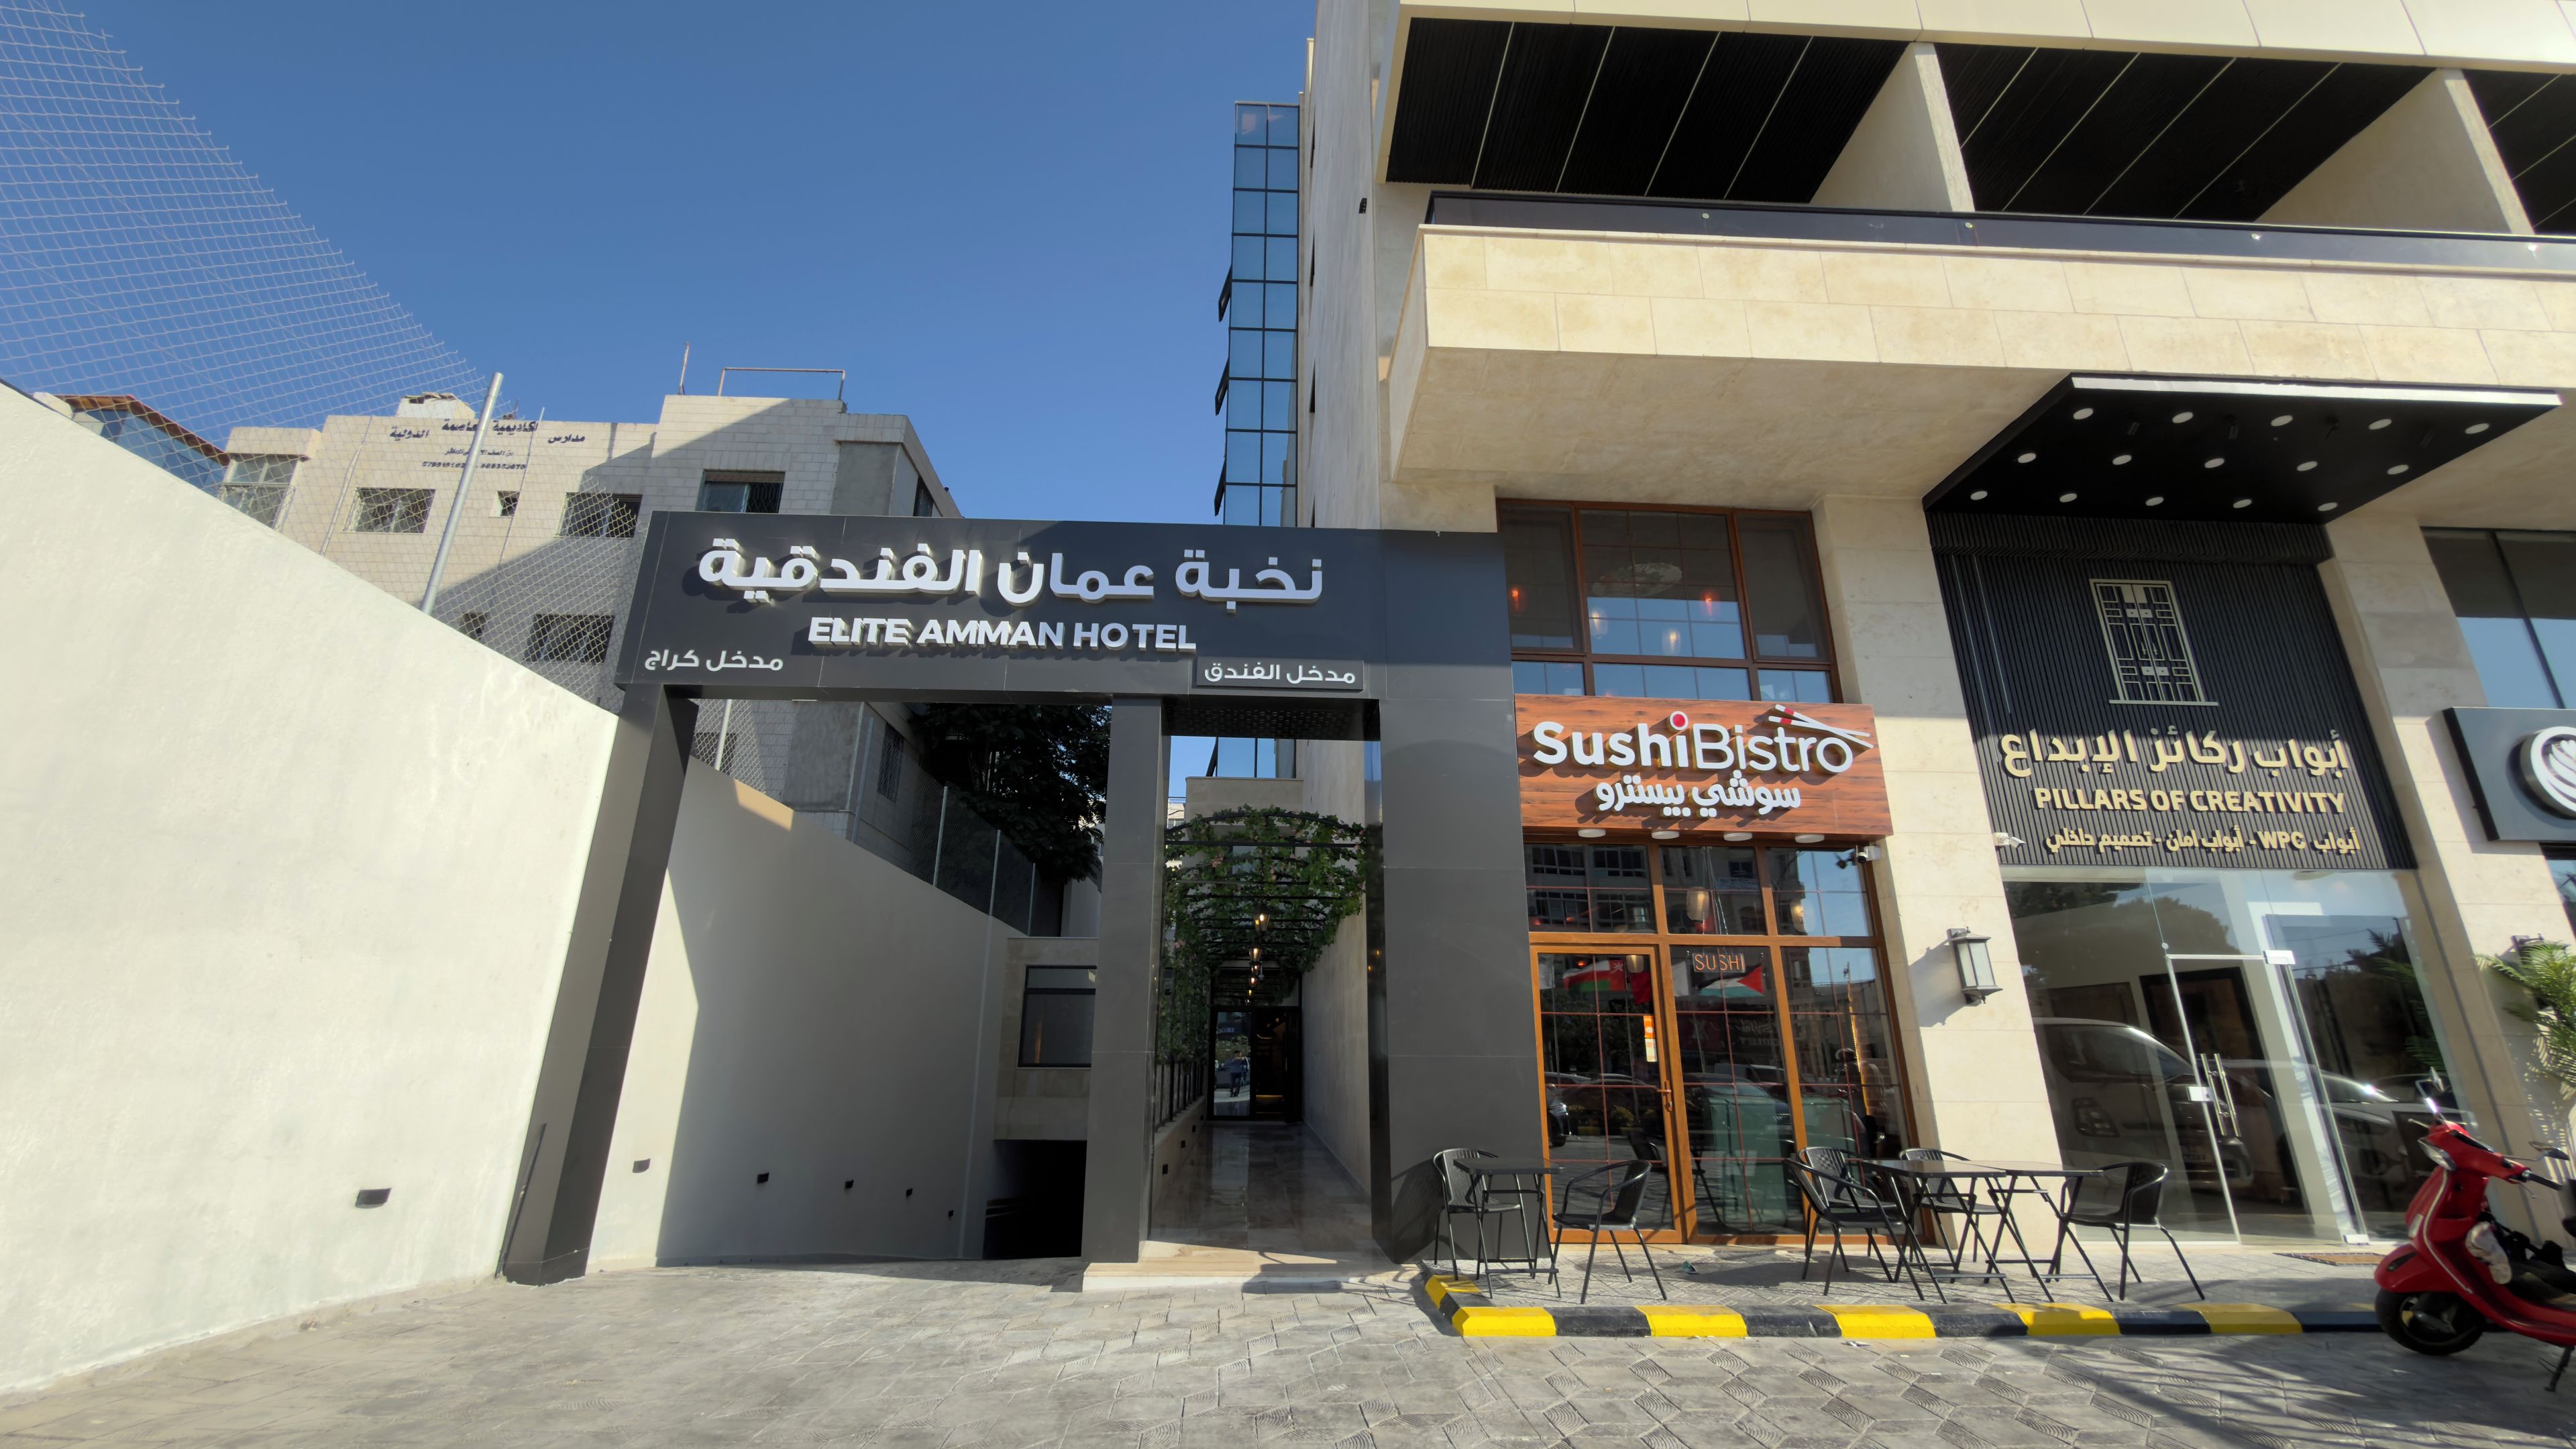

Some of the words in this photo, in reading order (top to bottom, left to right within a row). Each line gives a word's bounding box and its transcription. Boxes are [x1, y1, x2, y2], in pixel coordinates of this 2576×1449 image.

[390, 425, 429, 441] الدولية
[548, 433, 585, 443] مدارس
[698, 538, 983, 604] الفندقية
[997, 551, 1155, 606] عمان
[1175, 549, 1323, 614] نخبة
[808, 616, 913, 646] ELITE
[916, 619, 1065, 650] AMMAN
[1074, 622, 1197, 652] HOTEL
[644, 649, 700, 672] كراج
[706, 649, 784, 672] مدخل
[1204, 661, 1281, 682] الفندق
[1286, 665, 1356, 684] مدخل
[2000, 729, 2138, 777] الإبداع
[2149, 725, 2245, 773] ركائز
[2253, 729, 2349, 778] أبواب
[1595, 774, 1691, 817] بيسترو
[1692, 769, 1801, 818] سوشي
[2034, 788, 2147, 811] PILLARS
[2150, 790, 2185, 811] OF
[2190, 790, 2345, 813] CREATIVITY
[2046, 827, 2095, 853] داخلي
[2098, 830, 2153, 853] تصميم
[2165, 829, 2199, 852] امان
[2200, 824, 2244, 853] أبواب
[2257, 831, 2306, 849] WPC
[2313, 826, 2361, 854] أبواب
[1695, 953, 1744, 971] SUSHI
